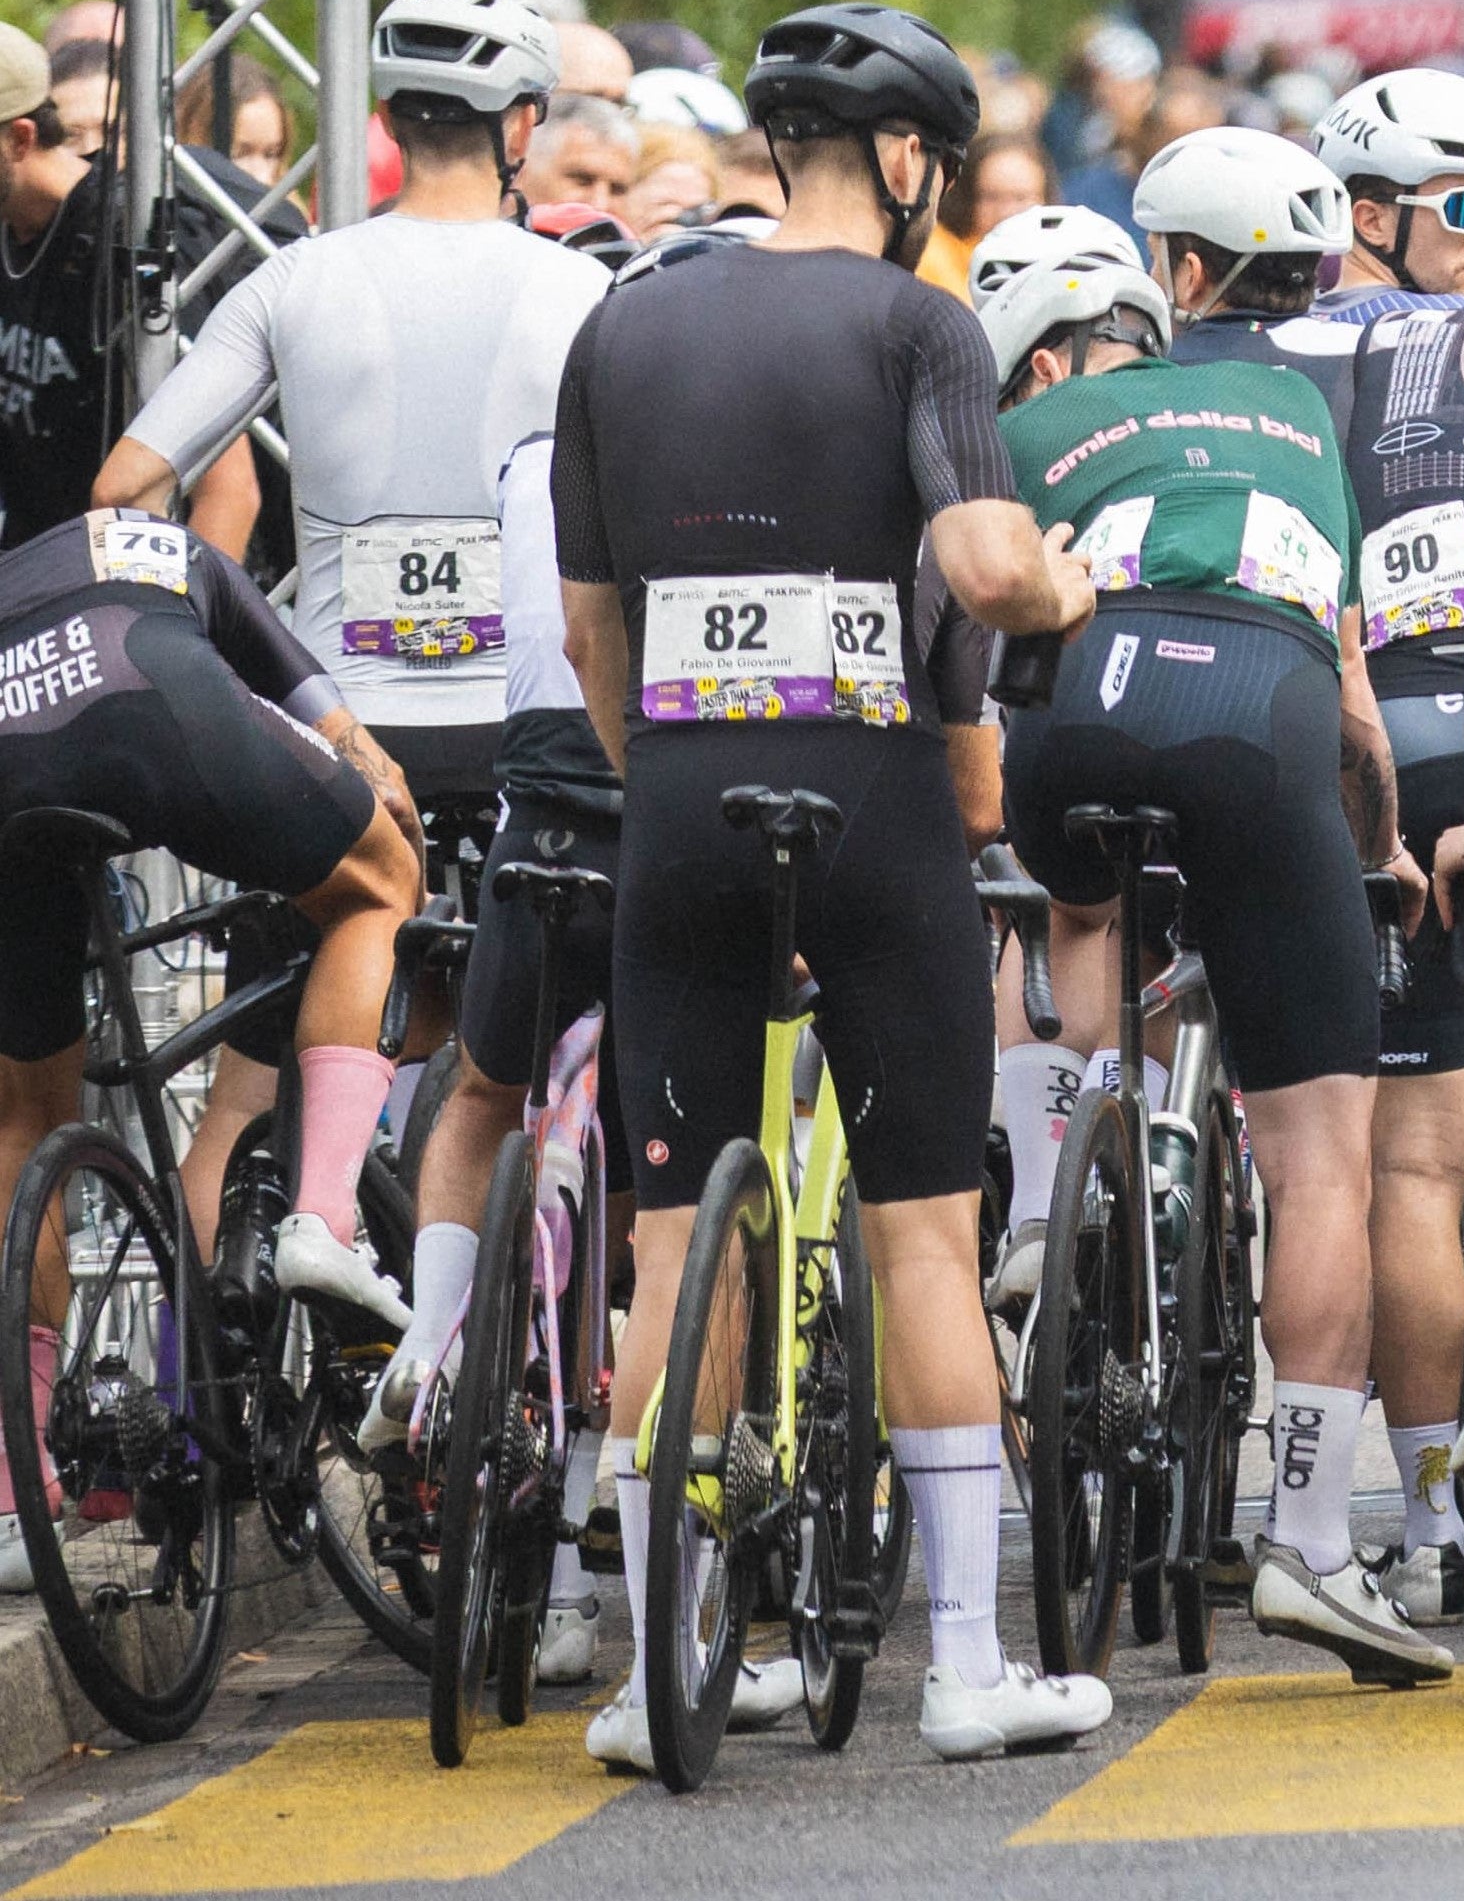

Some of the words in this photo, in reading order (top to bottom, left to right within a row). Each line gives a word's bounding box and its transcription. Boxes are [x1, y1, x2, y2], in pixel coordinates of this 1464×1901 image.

[1045, 417, 1140, 486] amici
[1146, 410, 1253, 432] della
[1258, 414, 1323, 458] bici
[117, 531, 179, 558] 76
[1384, 533, 1440, 585] 90
[400, 550, 462, 597] 84
[764, 586, 787, 598] PEAK
[789, 586, 813, 598] PUNK
[434, 599, 466, 611] Suter
[704, 602, 768, 652] 82
[831, 609, 887, 657] 82
[681, 657, 714, 671] Fabio
[716, 657, 734, 670] De
[737, 655, 793, 670] Giovanni
[699, 691, 733, 712] FASTER
[731, 686, 753, 704] THAN
[1282, 1404, 1324, 1491] amici
